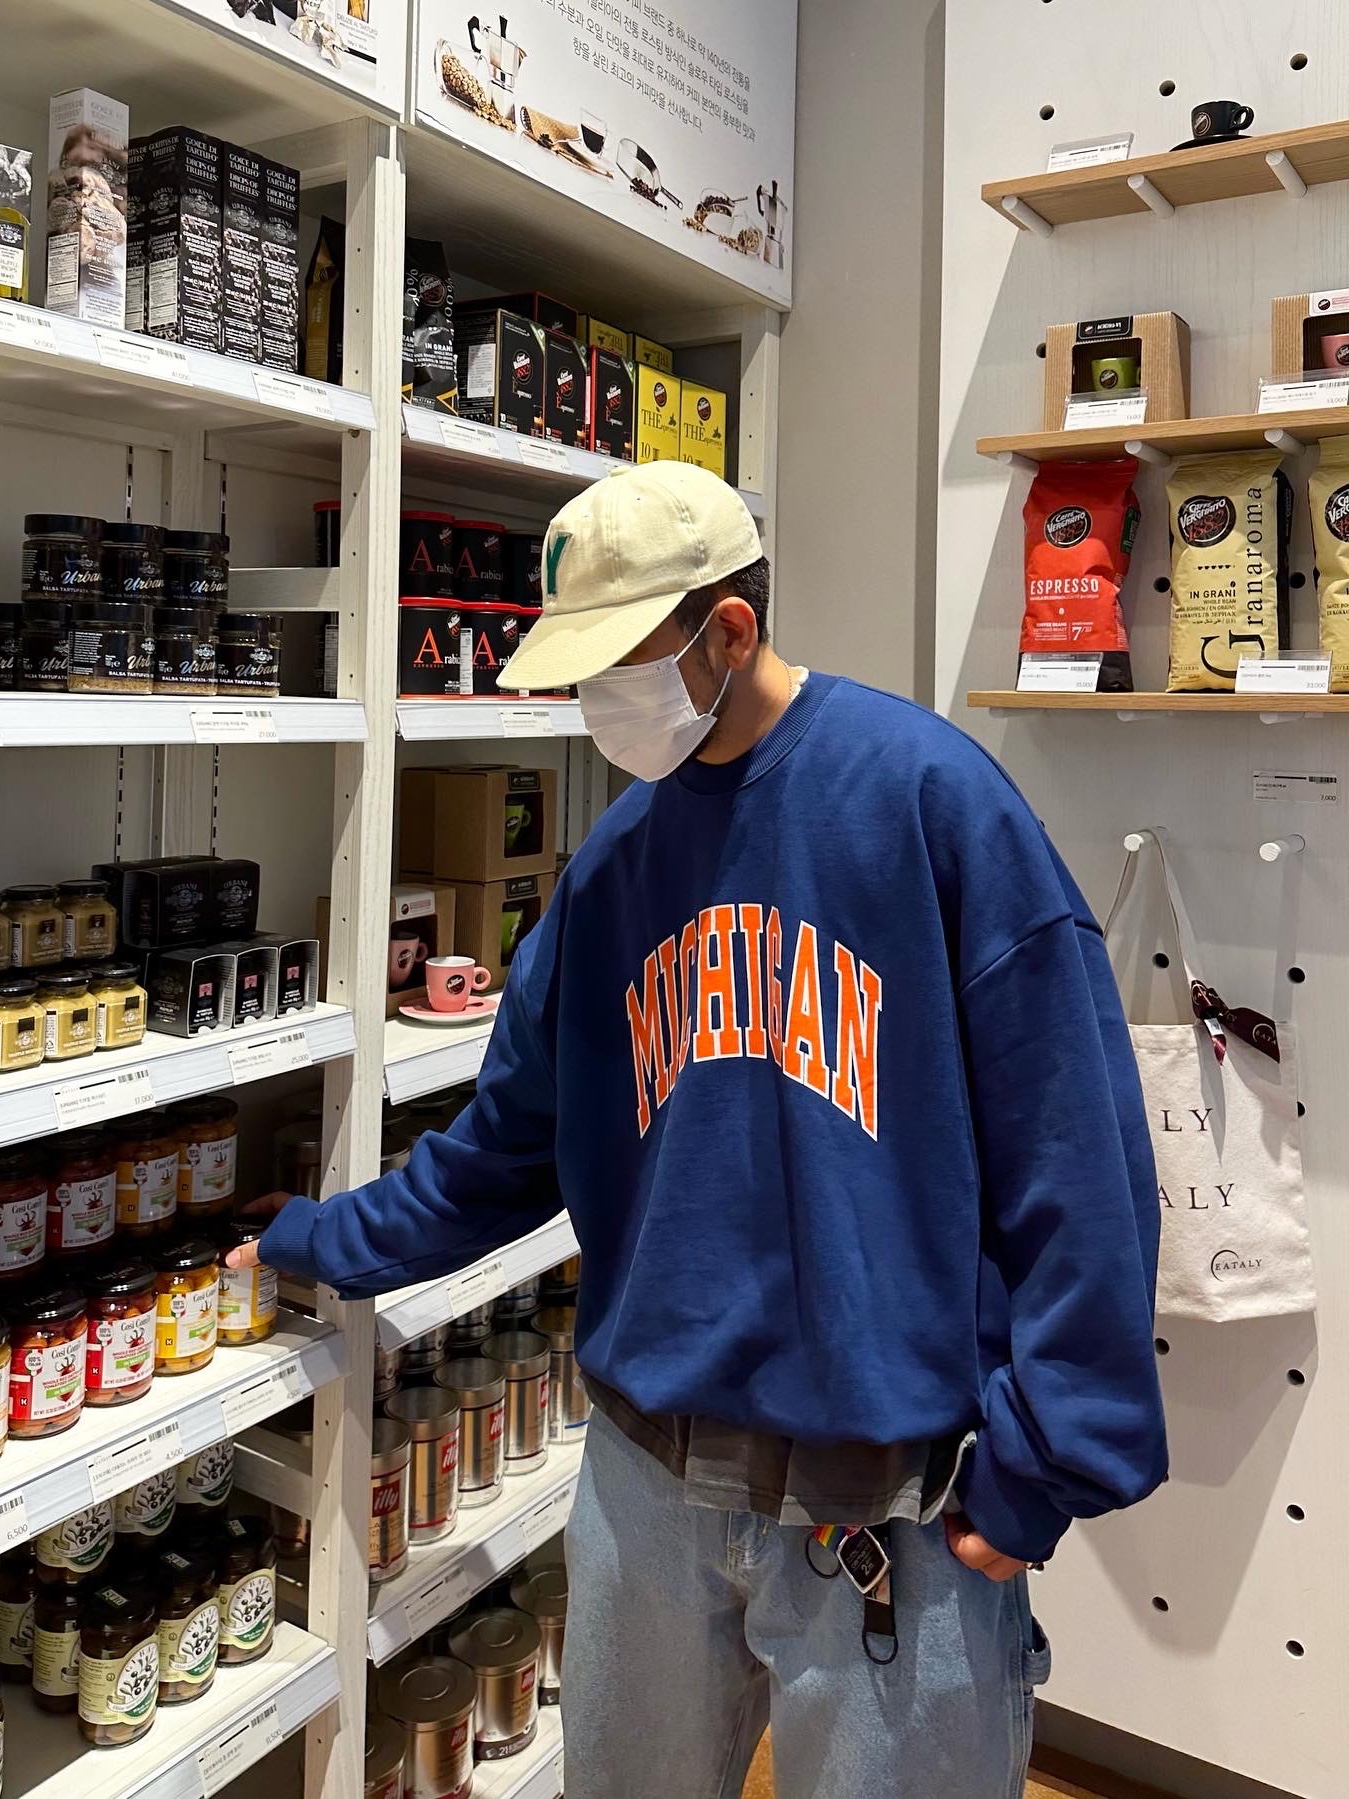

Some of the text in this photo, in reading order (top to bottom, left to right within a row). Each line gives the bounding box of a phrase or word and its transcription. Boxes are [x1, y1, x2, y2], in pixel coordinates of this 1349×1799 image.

[643, 3, 665, 29] 브랜드
[667, 20, 674, 37] 중
[624, 16, 639, 38] 전통
[641, 28, 663, 55] 로스팅
[665, 44, 686, 71] 방식인
[557, 1, 584, 27] 수분과
[606, 31, 630, 60] 단맛을
[632, 48, 655, 74] 최대로
[656, 65, 685, 95] 유지하여
[686, 85, 700, 106] 커피
[573, 36, 590, 61] 향을
[592, 51, 608, 73] 살린
[610, 62, 634, 88] 최고의
[209, 144, 217, 155] DI
[207, 163, 217, 173] OF
[251, 161, 259, 170] DI
[250, 179, 258, 189] OF
[288, 176, 296, 185] DI
[286, 194, 296, 203] OF
[641, 442, 650, 459] 10
[547, 531, 573, 599] Y
[1030, 578, 1099, 595] ESPRESSO
[1201, 487, 1265, 678] Granaroma
[1189, 590, 1236, 599] IN GRANI
[625, 903, 882, 1142] MICHIGAN
[1214, 1258, 1263, 1271] EATALY
[166, 1448, 183, 1460] 4,500
[374, 1488, 398, 1511] illy
[6, 1524, 28, 1541] 6,500
